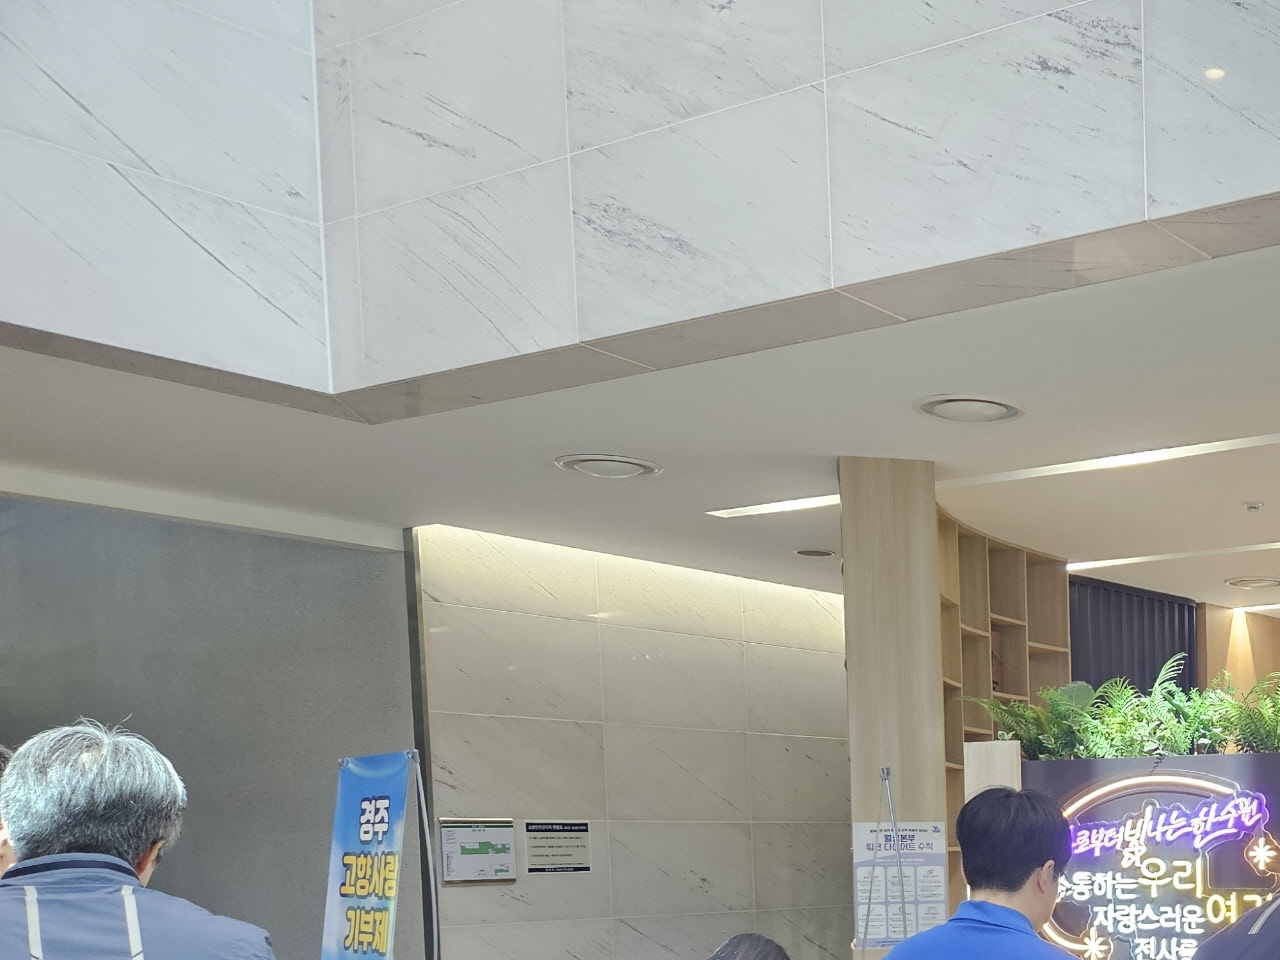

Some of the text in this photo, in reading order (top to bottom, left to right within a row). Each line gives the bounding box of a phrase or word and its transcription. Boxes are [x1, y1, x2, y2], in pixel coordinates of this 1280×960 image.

[359, 798, 390, 843] 경주
[340, 853, 399, 898] 고향사랑
[1137, 856, 1203, 899] 우리
[344, 908, 389, 954] 기부제
[1093, 904, 1206, 934] 자랑스러운
